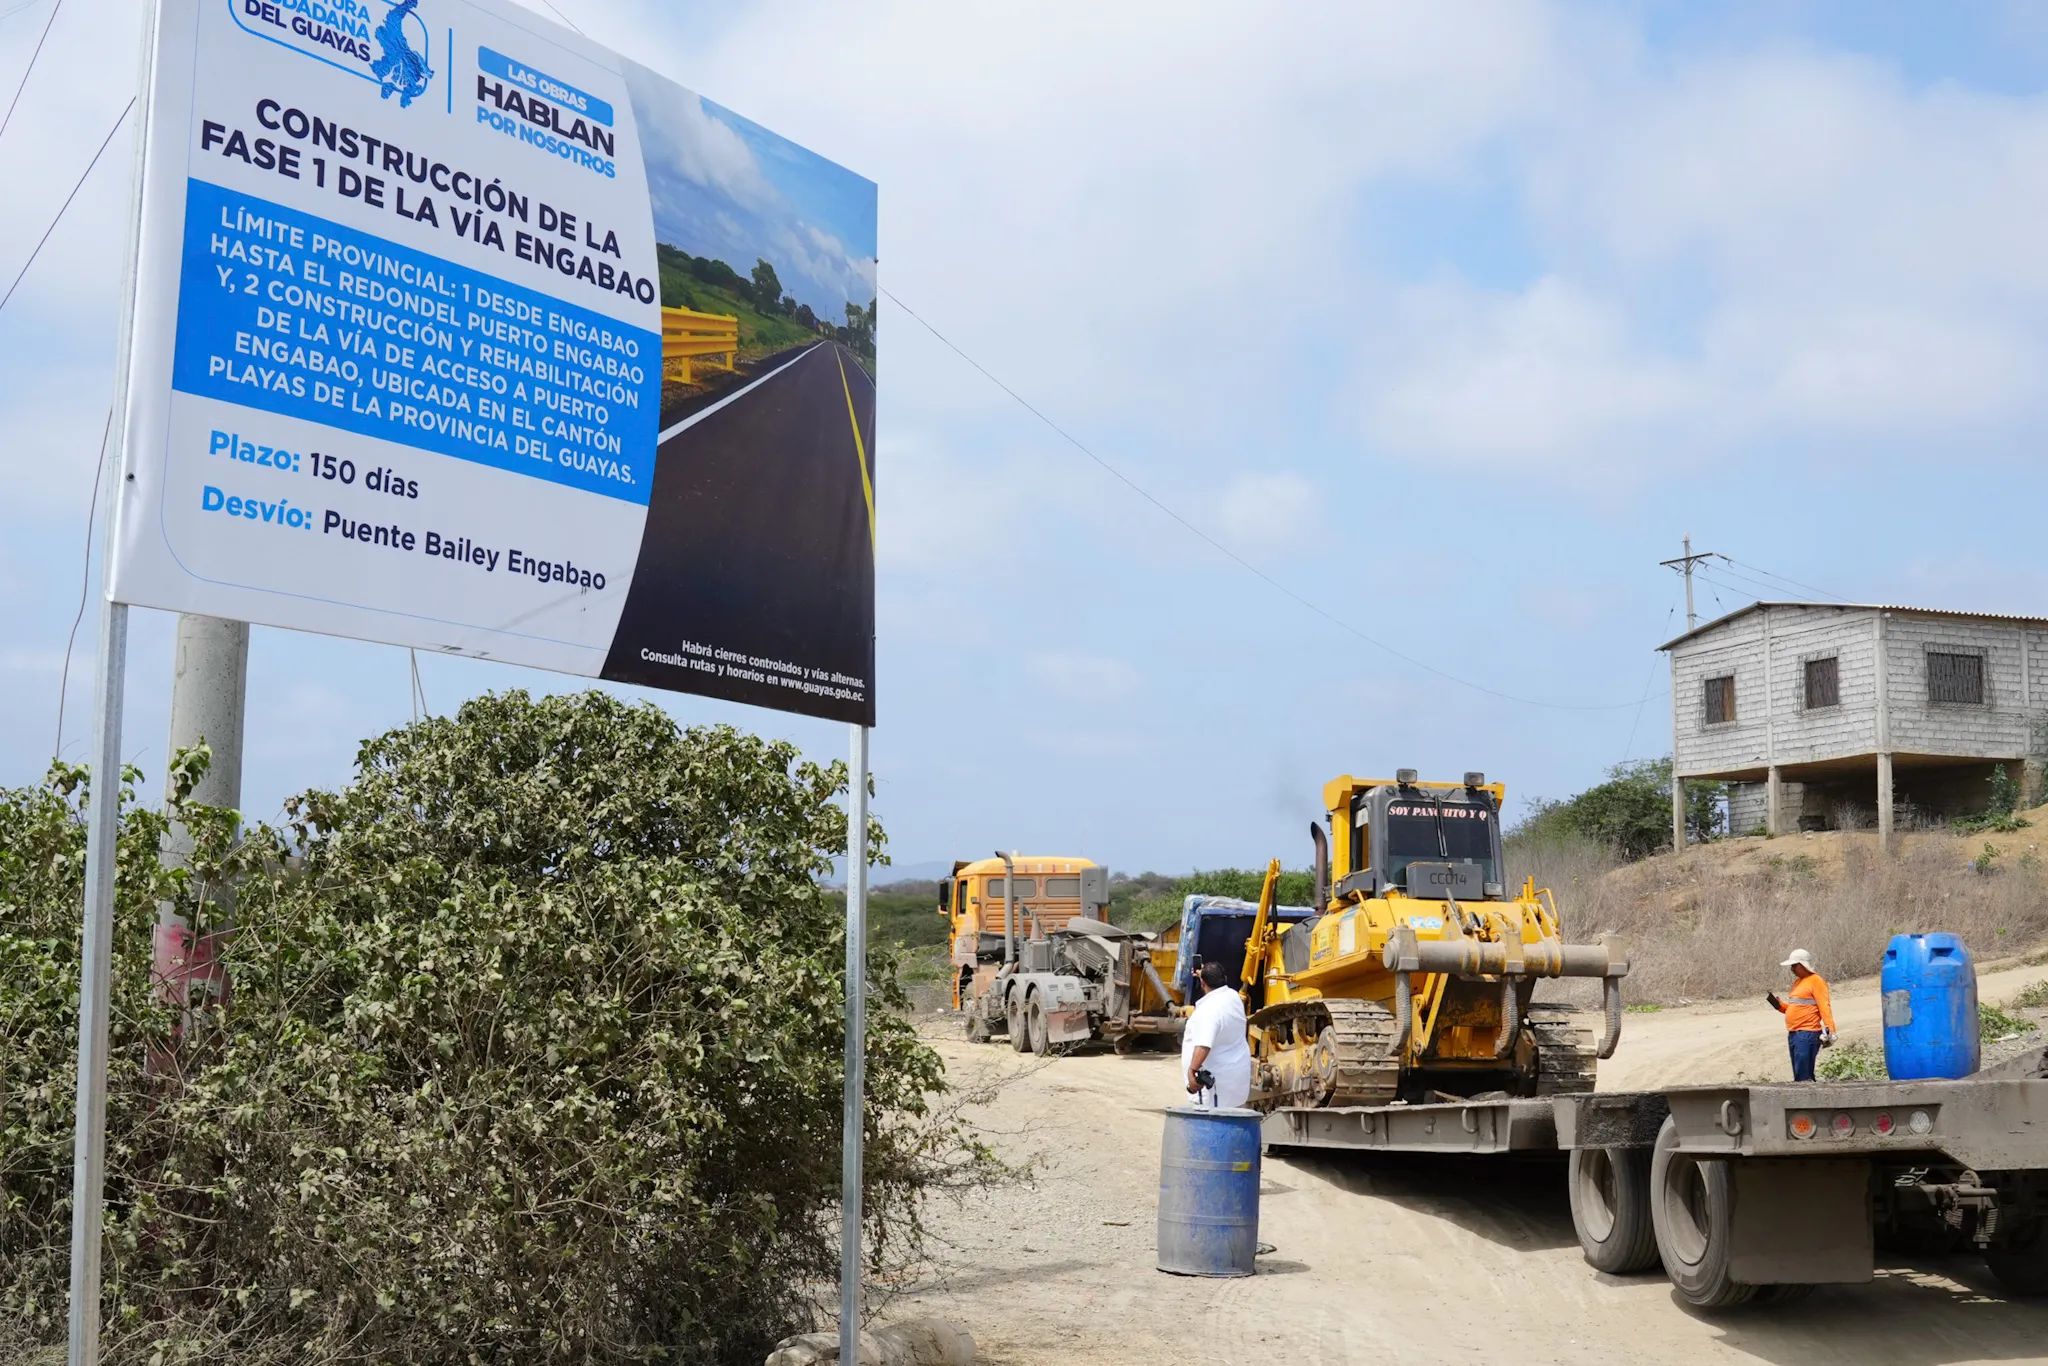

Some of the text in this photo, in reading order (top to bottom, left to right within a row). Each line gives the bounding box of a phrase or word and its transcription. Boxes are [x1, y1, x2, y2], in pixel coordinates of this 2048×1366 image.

[245, 0, 287, 29] DEL
[292, 16, 371, 62] GUAYAS
[477, 75, 614, 158] HABLAN
[508, 64, 587, 111] LAS OBRAS
[256, 99, 622, 259] CONSTRUCCIÓN DE LA
[477, 105, 615, 179] POR NOSOTROS
[201, 120, 655, 305] FASE 1 DE LA VÍA ENGABAO
[211, 233, 644, 385] HASTA EL REDONDEL PUERTO ENGABAO
[221, 206, 639, 358] LÍMITE PROVINCIAL: 1 DESDE ENGABAO
[216, 265, 639, 409] Y, 2 CONSTRUCCIÓN Y REHABILITACIÓN
[257, 306, 609, 425] DE LA VÍA DE ACCESO A PUERTO
[209, 355, 636, 484] PLAYAS DE LA PROVINCIA DEL GUAYAS.
[235, 331, 621, 455] ENGABAO, UBICADA EN EL CANTÓN
[209, 430, 419, 500] Plazo: 150 días
[201, 486, 606, 591] Desvío: Puente Bailey Engabao
[640, 648, 864, 702] Consulta rutas y horarios en www.guayas.gob.ec.
[682, 640, 865, 689] Habrá cierres controlados y vías alternas.
[1389, 806, 1410, 816] SOY
[1469, 810, 1477, 819] Y
[1479, 810, 1487, 821] Q
